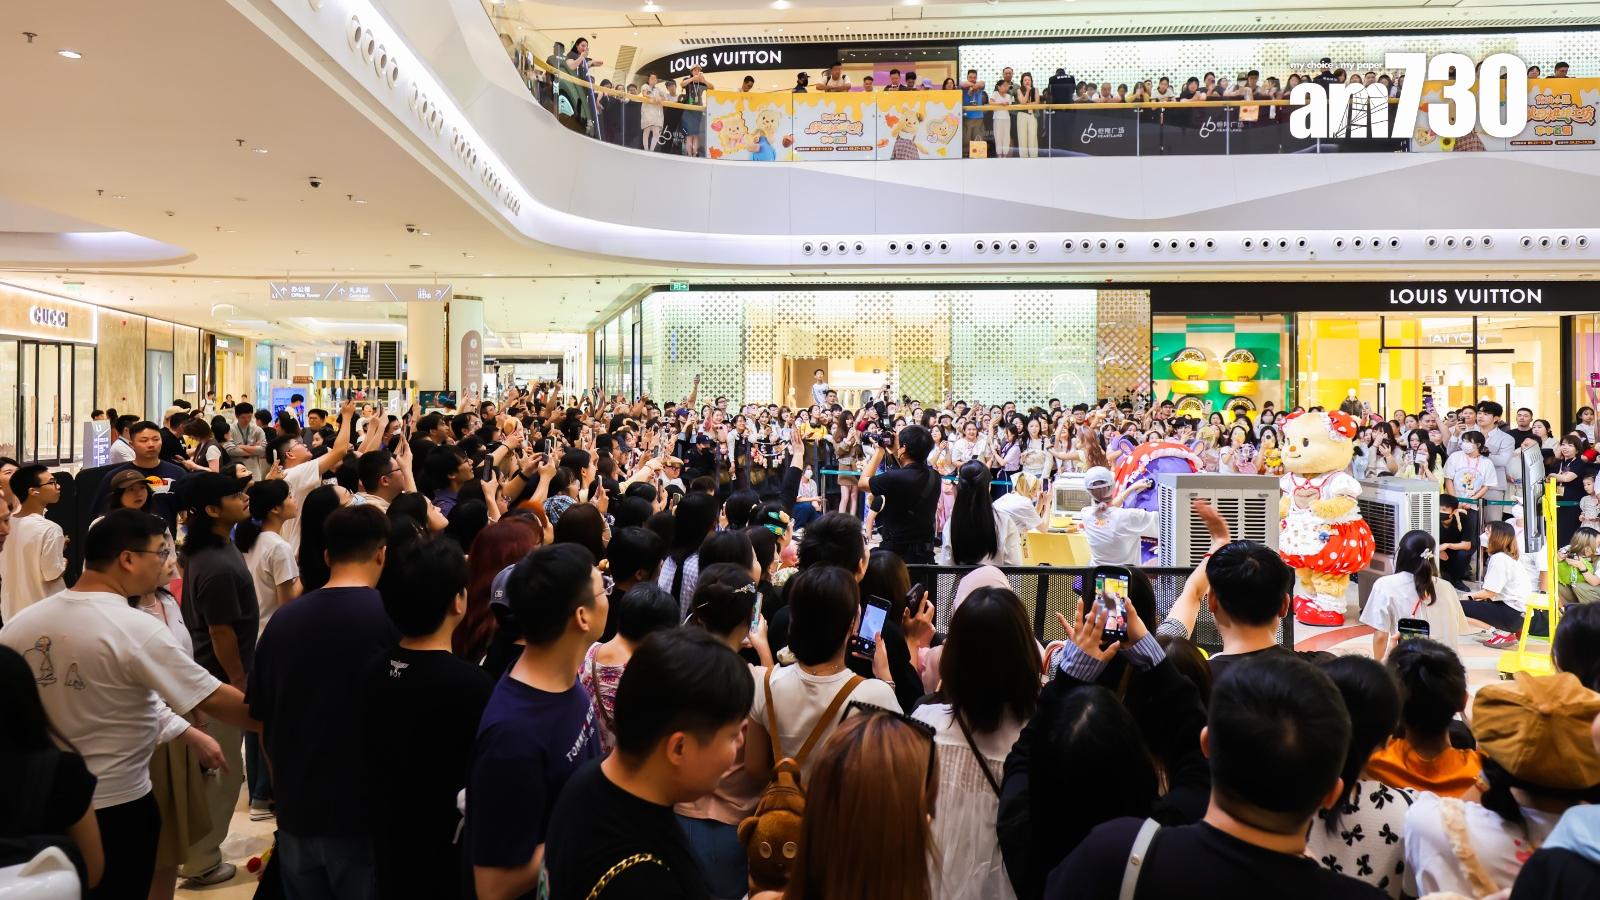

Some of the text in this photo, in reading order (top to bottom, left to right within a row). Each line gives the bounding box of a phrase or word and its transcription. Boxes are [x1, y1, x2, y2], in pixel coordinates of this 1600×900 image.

[670, 50, 782, 73] LOUIS VUITTON
[1390, 288, 1542, 304] LOUIS VUITTON
[32, 306, 69, 328] GUCCI
